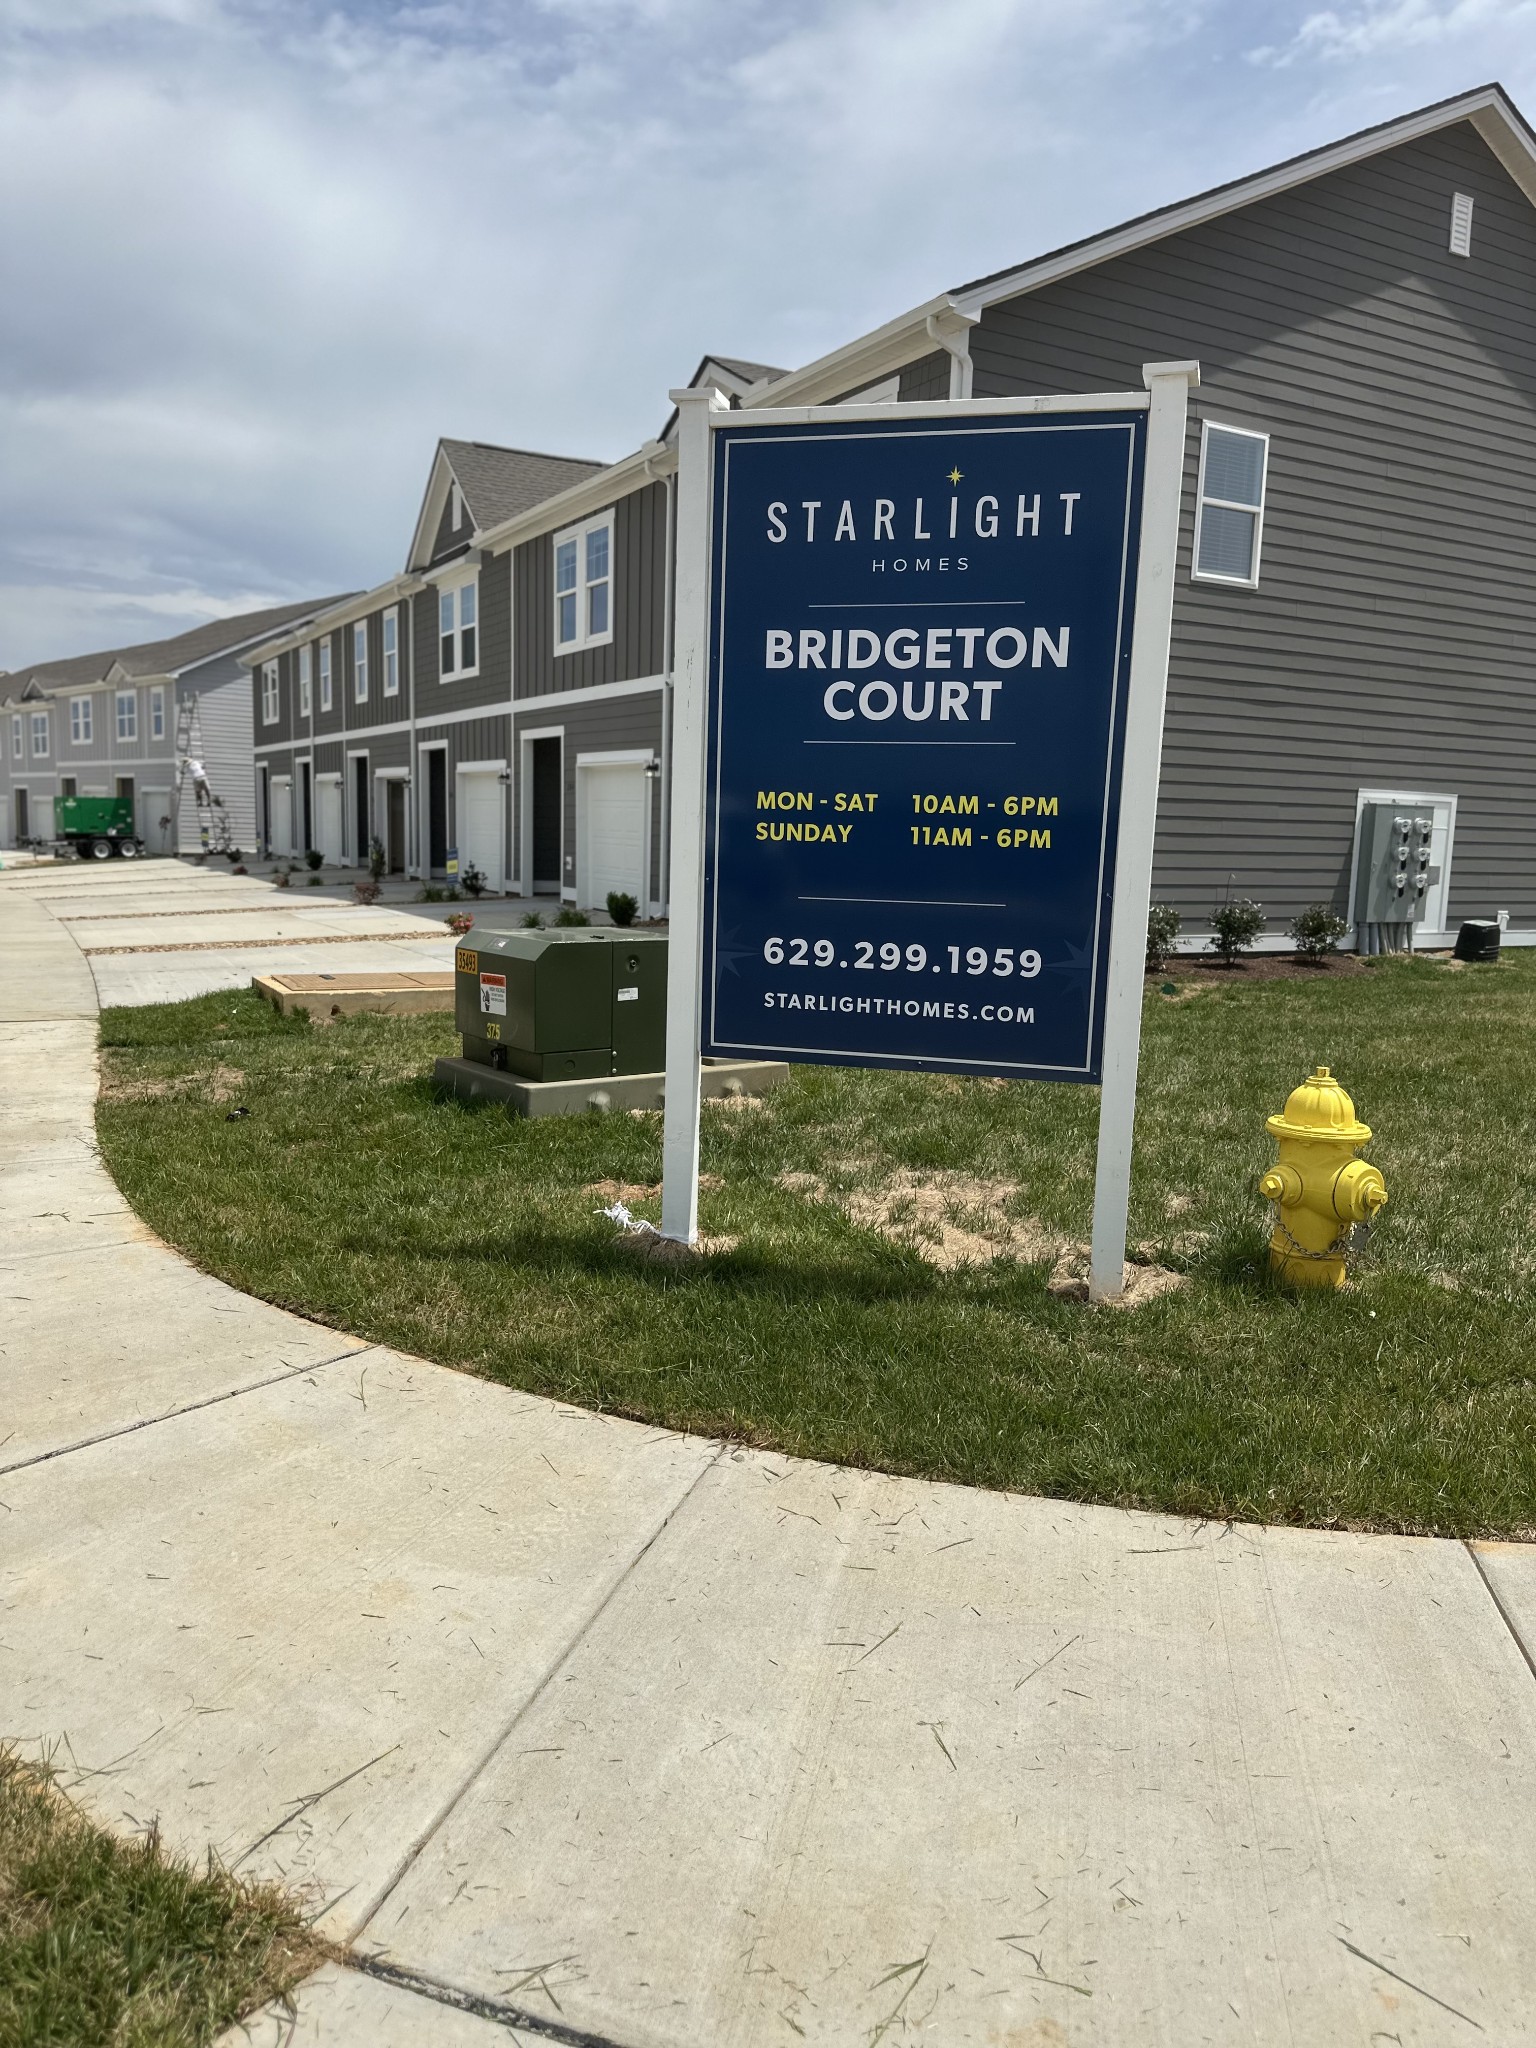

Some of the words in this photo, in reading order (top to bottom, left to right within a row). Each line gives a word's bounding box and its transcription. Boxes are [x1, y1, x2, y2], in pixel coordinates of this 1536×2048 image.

[766, 492, 1083, 543] STARLIGHT
[872, 557, 970, 573] HOMES
[765, 626, 1070, 670] BRIDGETON
[823, 680, 1003, 722] COURT
[756, 791, 813, 811] MON
[834, 792, 879, 812] SAT
[912, 794, 979, 815] 10AM
[1003, 796, 1059, 816] 6PM
[755, 822, 853, 843] SUNDAY
[910, 826, 972, 847] 11AM
[996, 828, 1052, 849] 6PM
[458, 951, 476, 972] 35493
[763, 937, 1042, 978] 629.299.1959
[763, 992, 1035, 1024] STARLIGHTHOMES.COM
